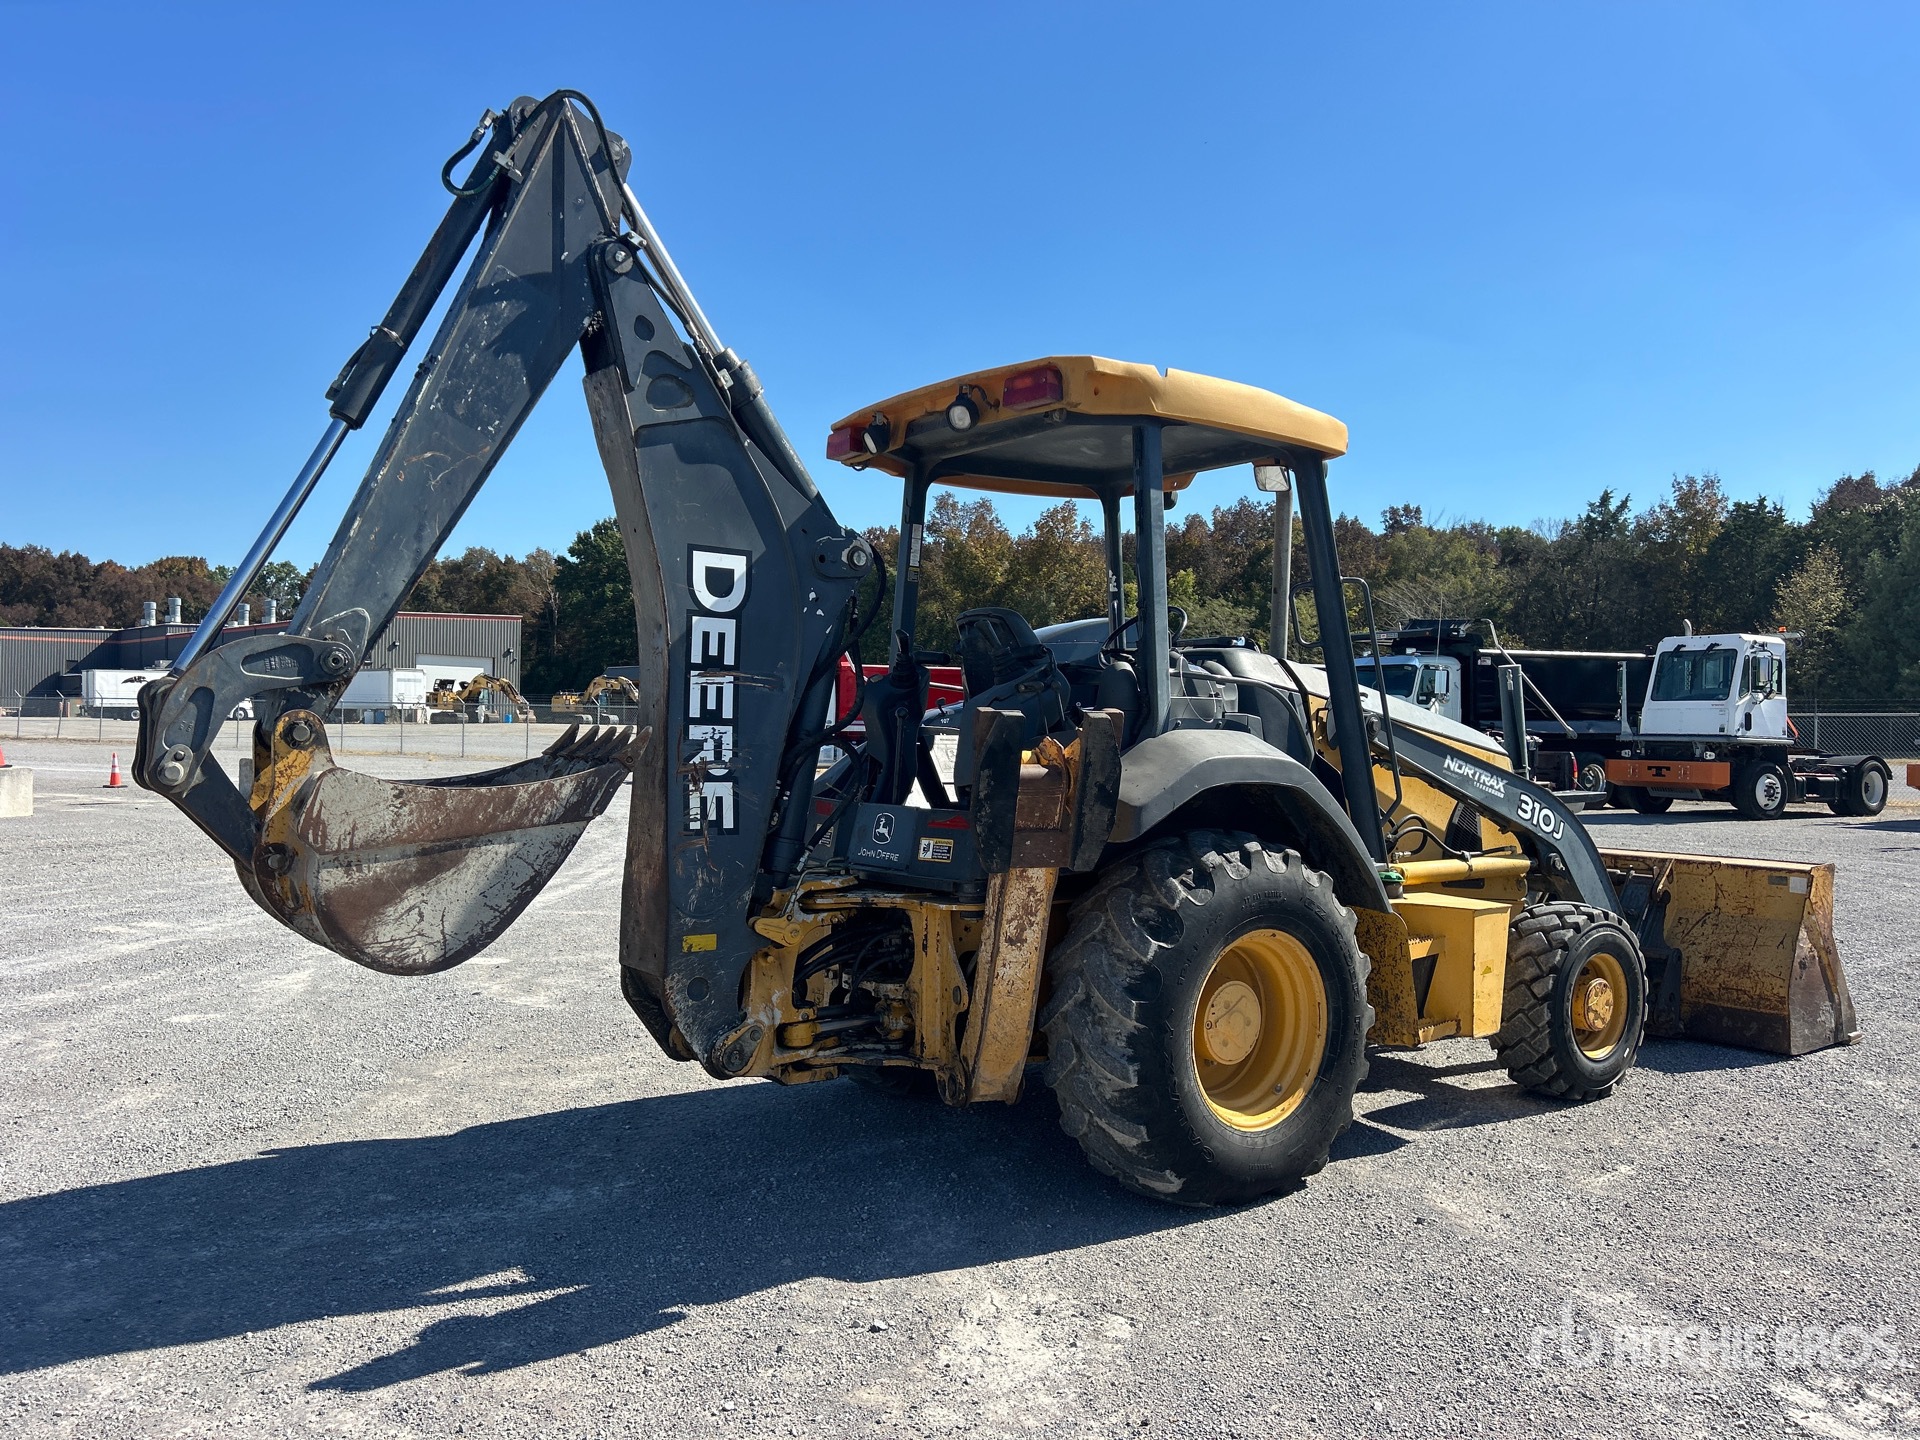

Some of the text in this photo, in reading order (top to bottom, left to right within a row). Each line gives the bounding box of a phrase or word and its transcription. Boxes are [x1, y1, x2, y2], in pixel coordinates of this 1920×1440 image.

[689, 550, 747, 830] DEERE
[1442, 754, 1509, 793] NORTRAX
[1517, 793, 1566, 840] 310J
[858, 846, 900, 862] JOHN DEERE
